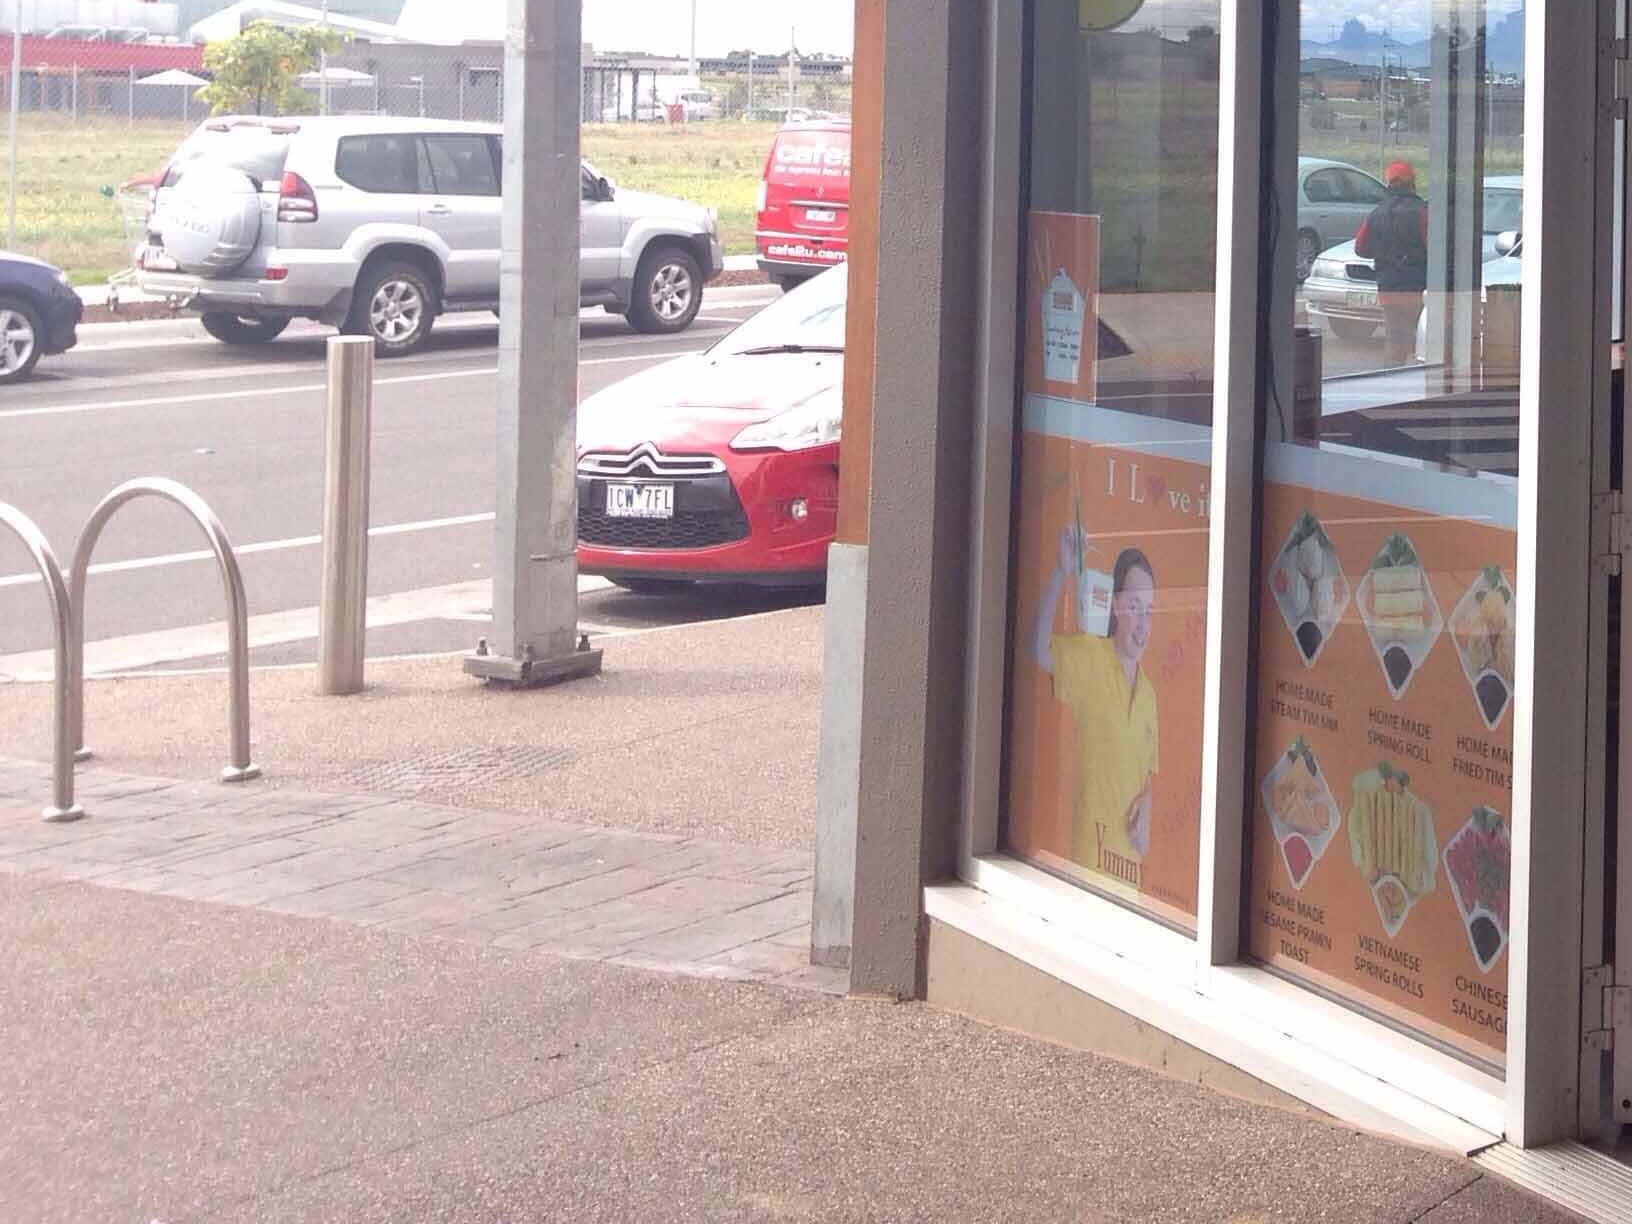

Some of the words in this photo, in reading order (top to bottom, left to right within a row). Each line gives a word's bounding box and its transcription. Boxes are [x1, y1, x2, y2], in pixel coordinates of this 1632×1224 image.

[1105, 457, 1116, 497] I
[1305, 687, 1337, 710] MADE
[1368, 707, 1400, 730] HOME
[1401, 714, 1433, 741] MADE
[1367, 727, 1405, 756] SPRING
[1406, 743, 1432, 764] ROLL
[1456, 735, 1489, 759] HOME
[1452, 756, 1483, 780] FRIED
[1484, 767, 1505, 788] TIM
[1261, 910, 1296, 937] ESAME
[1266, 889, 1296, 912] HOME
[1297, 900, 1326, 925] MADE
[1280, 939, 1310, 965] TOAST
[1358, 935, 1422, 973] VIETNAMESE
[1354, 955, 1391, 984] SPRING
[1392, 970, 1425, 999] ROLLS
[1451, 998, 1506, 1033] SAUSAG
